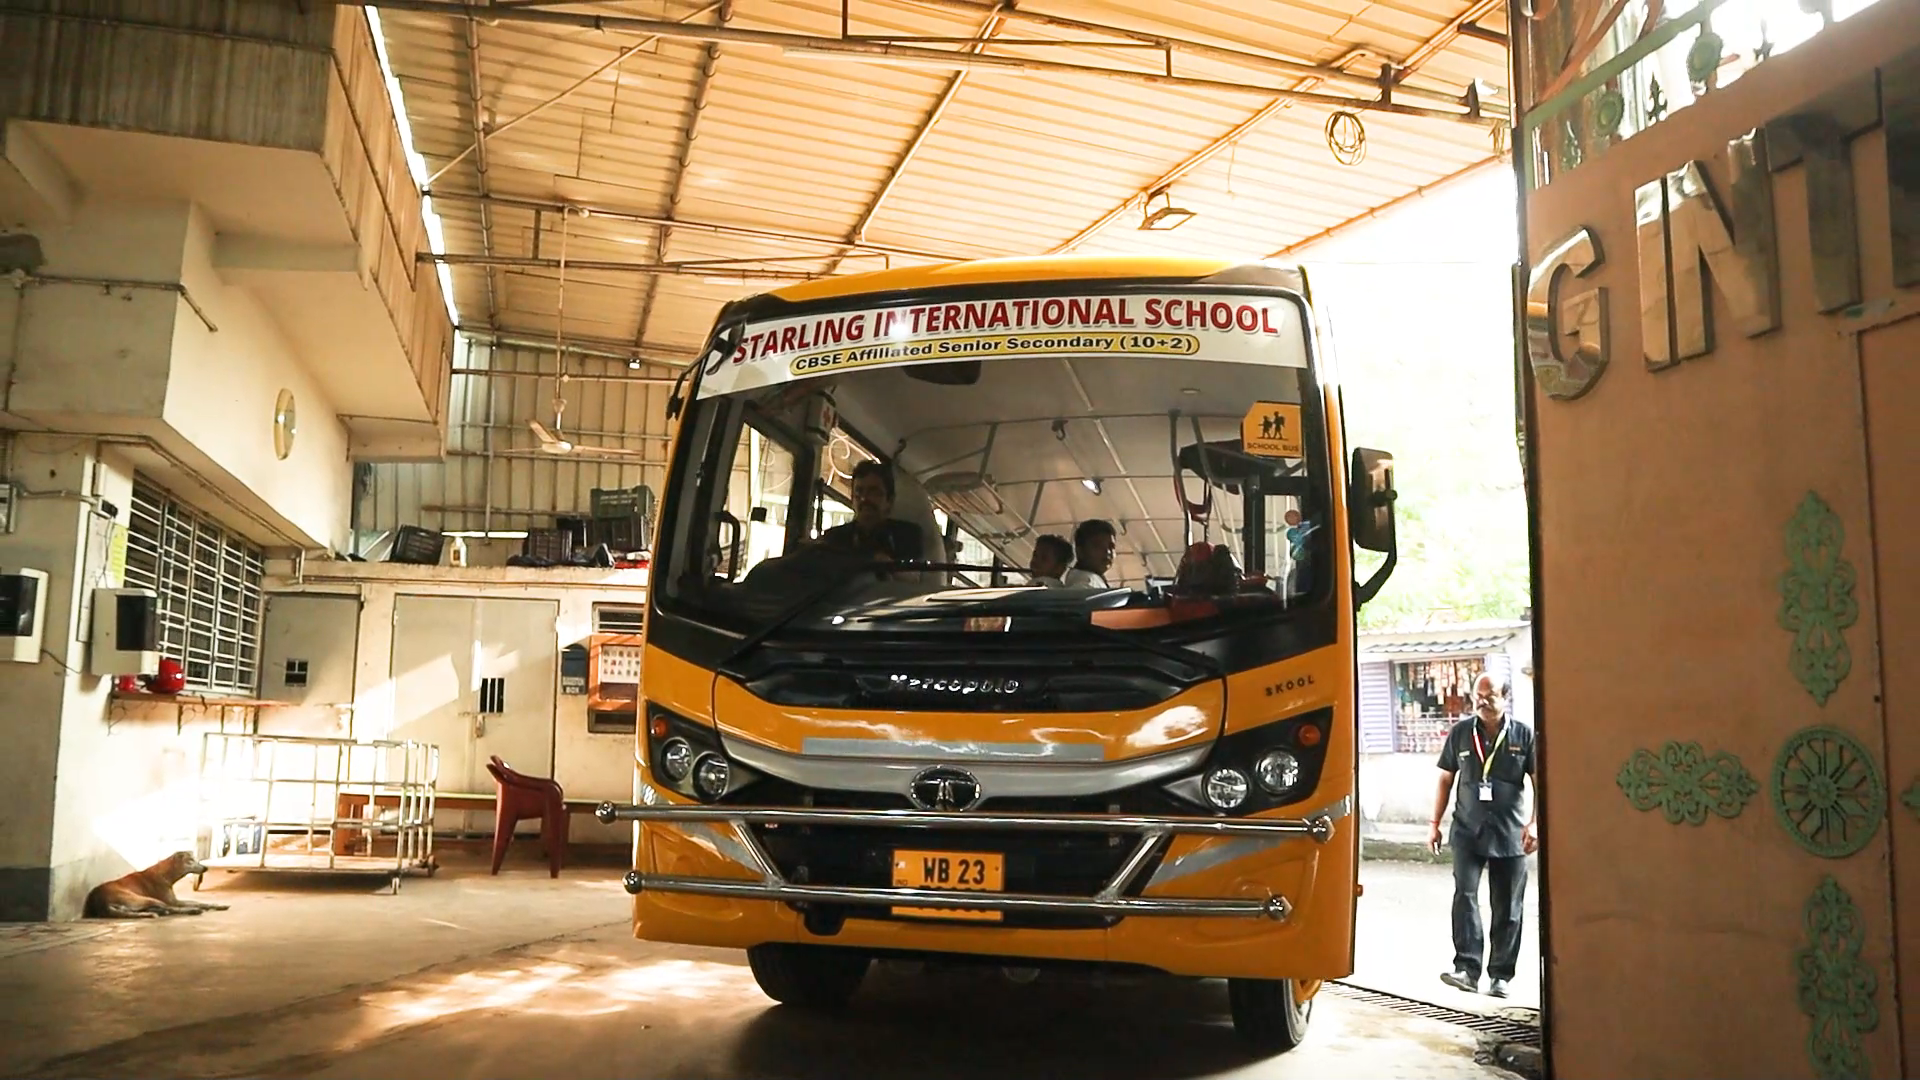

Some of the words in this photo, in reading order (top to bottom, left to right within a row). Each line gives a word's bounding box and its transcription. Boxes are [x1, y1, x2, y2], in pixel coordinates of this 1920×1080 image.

[733, 314, 865, 364] STARLING
[873, 298, 1135, 338] INTERNATIONAL
[1145, 298, 1278, 334] SCHOOL
[795, 352, 843, 371] CBSE
[846, 343, 932, 363] Affiliated
[938, 339, 1001, 354] Senior
[1006, 336, 1114, 350] Secondary
[1120, 336, 1192, 353] (10+2)
[1246, 442, 1281, 451] SCHOOL
[1282, 444, 1300, 452] BUS
[889, 674, 1019, 694] Marcopolo
[1265, 675, 1315, 697] SKOOL
[923, 857, 951, 884] WB
[957, 859, 986, 886] 23
